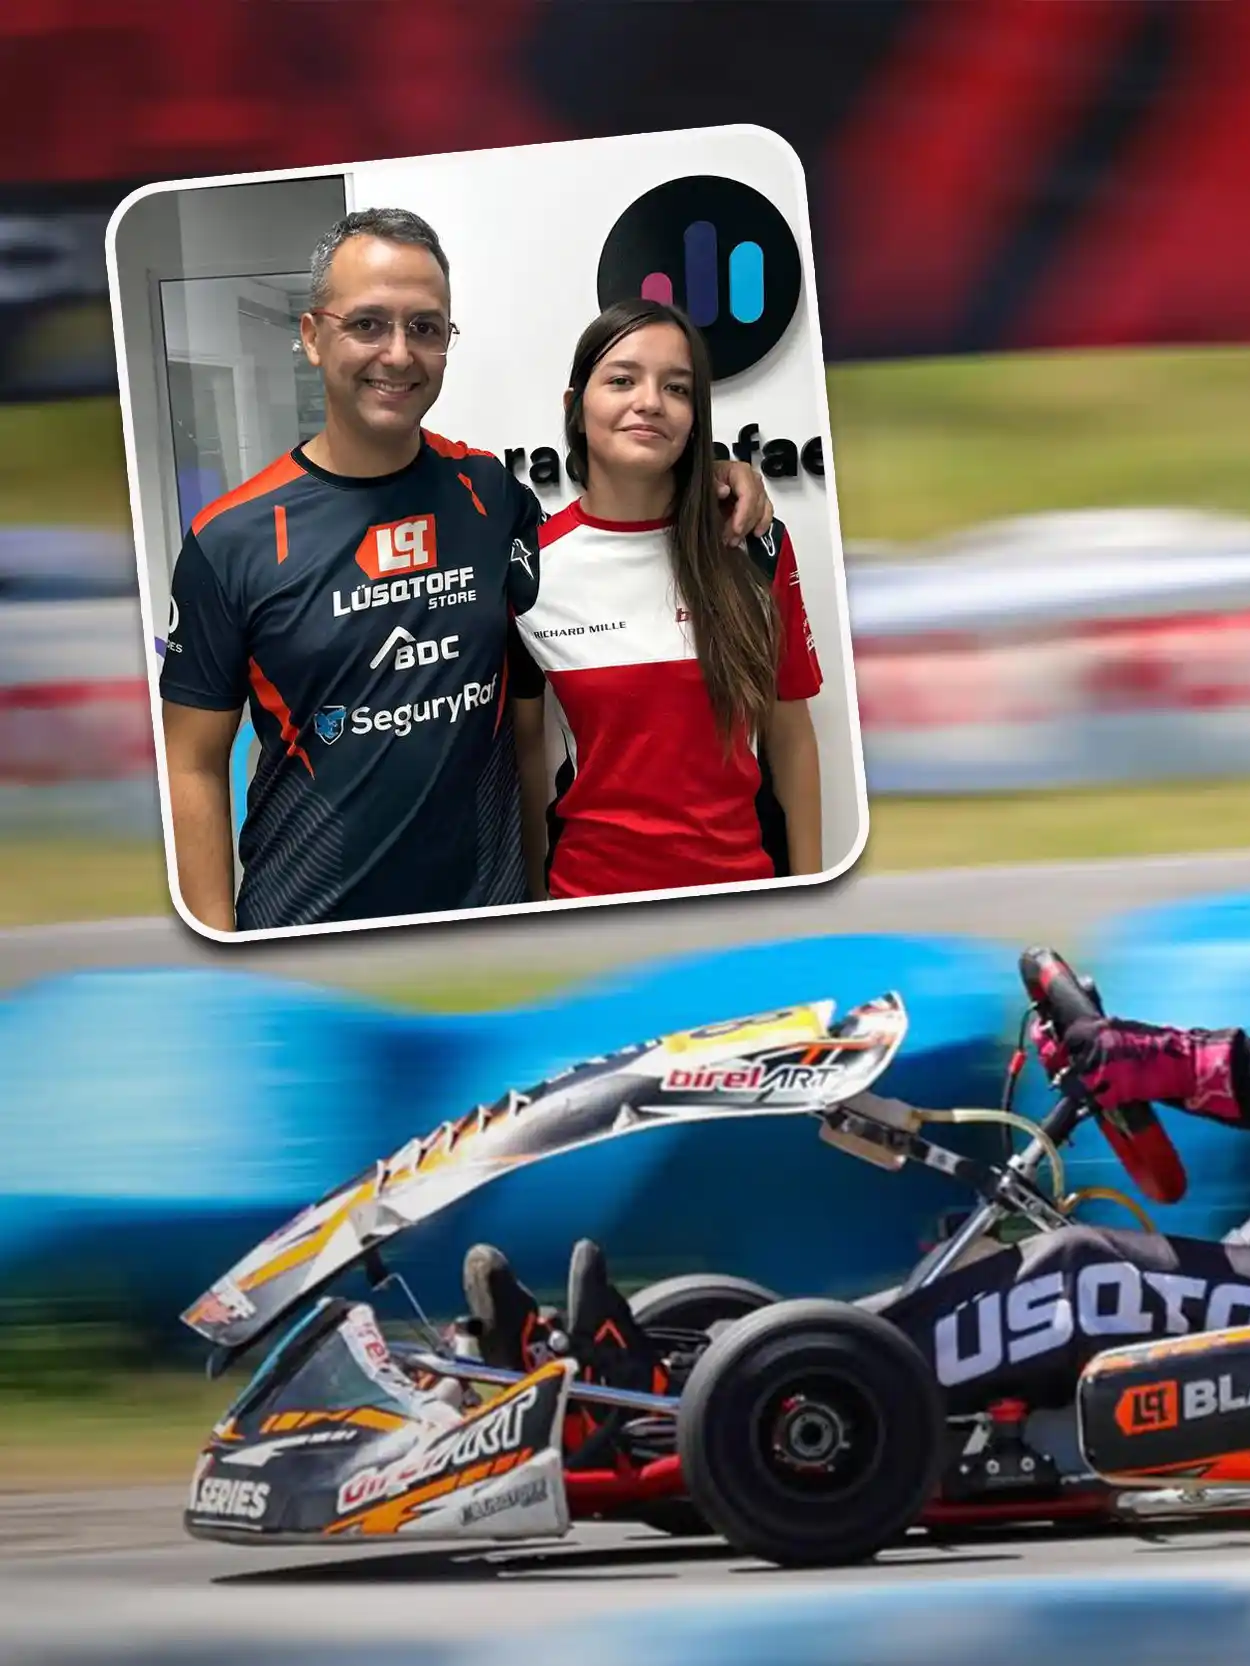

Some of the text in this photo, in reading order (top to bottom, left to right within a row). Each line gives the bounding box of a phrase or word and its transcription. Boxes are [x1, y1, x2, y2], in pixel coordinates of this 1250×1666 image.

[428, 590, 477, 610] STORE
[534, 621, 627, 639] RICHARD MILLE
